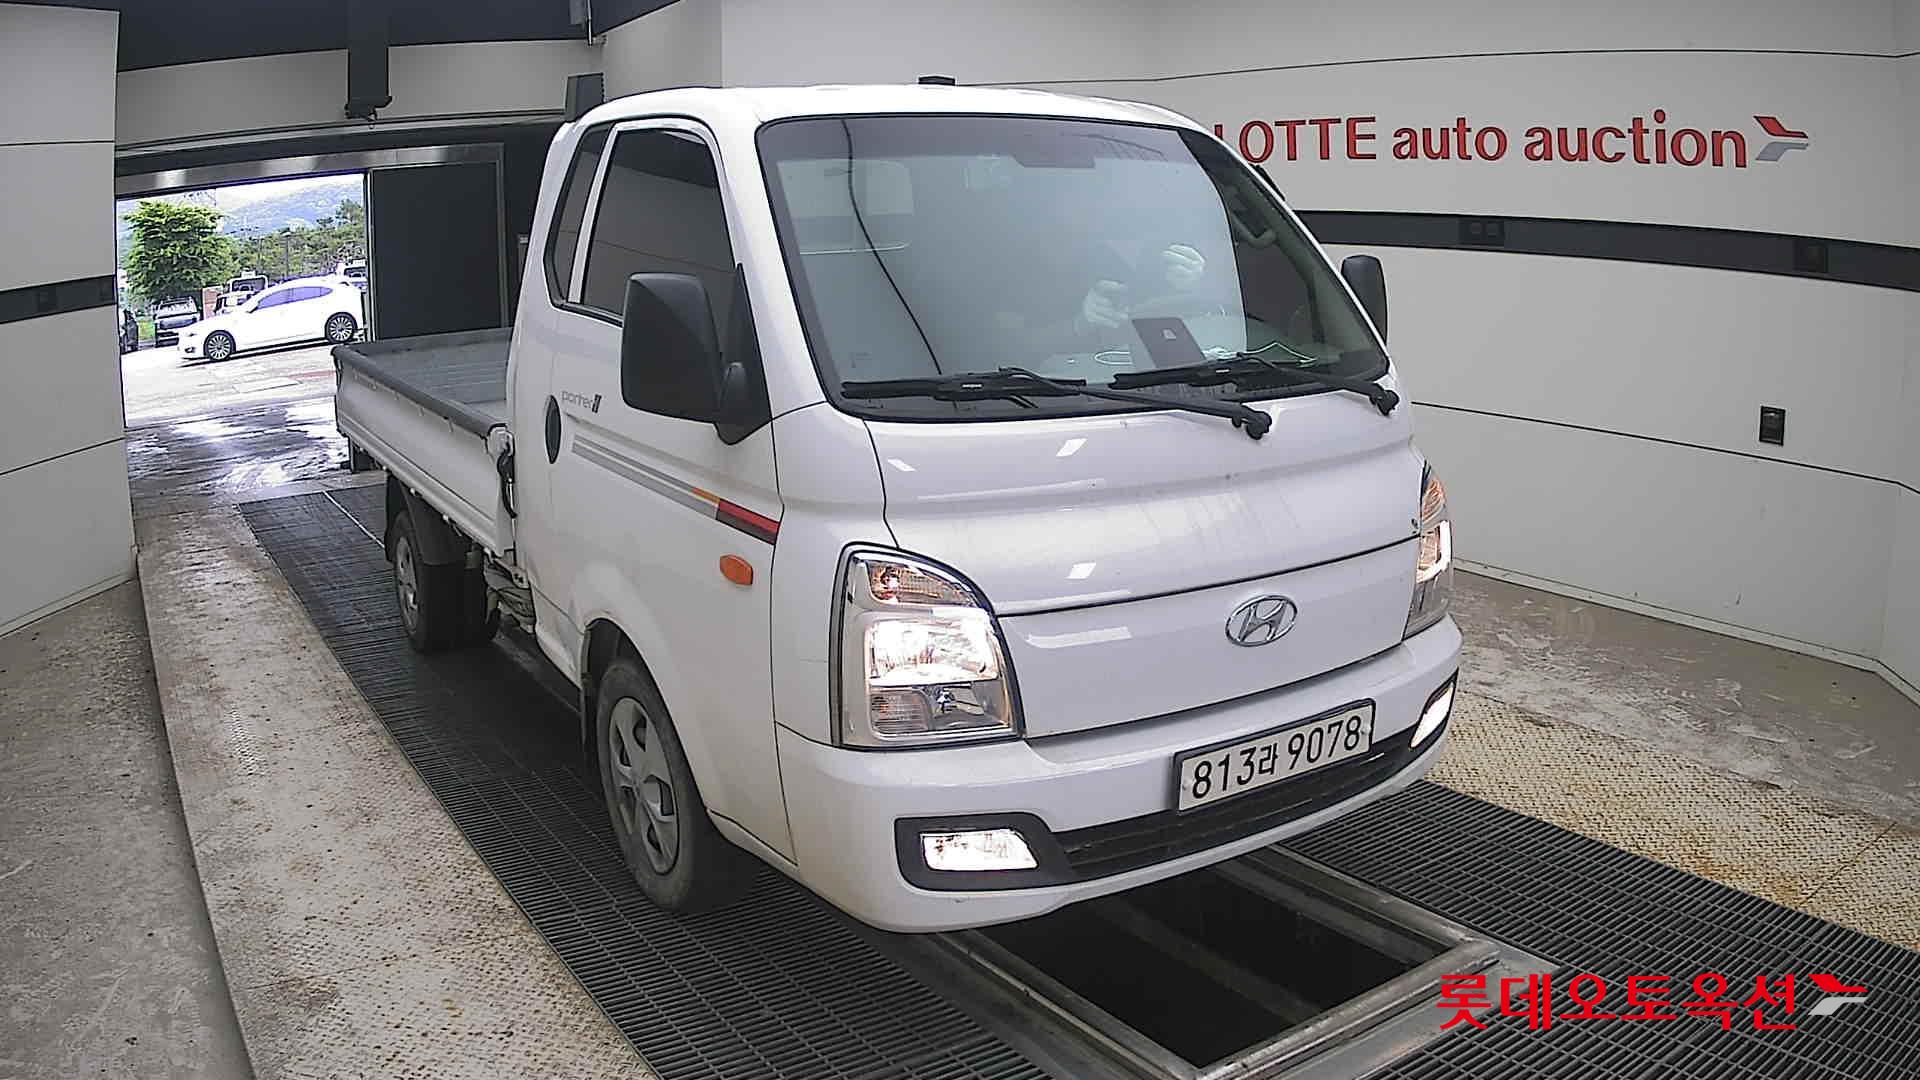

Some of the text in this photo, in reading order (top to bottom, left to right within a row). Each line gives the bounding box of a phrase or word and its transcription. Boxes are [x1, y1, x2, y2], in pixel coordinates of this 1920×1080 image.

[1214, 109, 1748, 169] OTTE auto auction
[1192, 715, 1362, 799] 813라 9078
